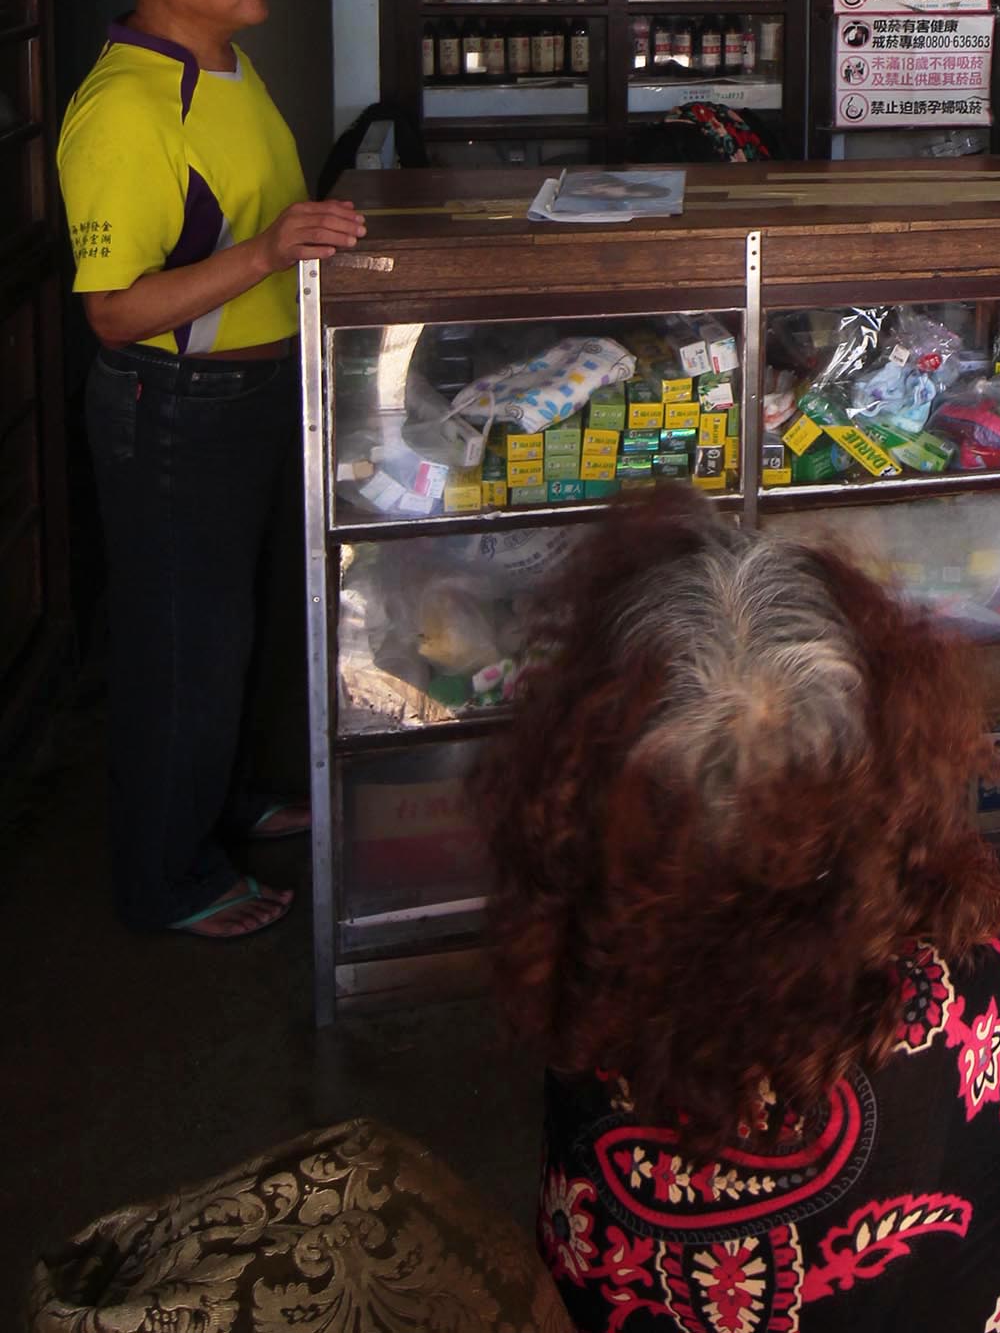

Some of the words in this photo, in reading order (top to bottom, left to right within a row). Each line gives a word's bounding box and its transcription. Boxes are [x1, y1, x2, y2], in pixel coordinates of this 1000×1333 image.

[873, 20, 959, 33] 吸菸有害健康
[872, 57, 984, 70] 未滿18歲不得吸菸
[871, 73, 982, 86] 及禁止供應其菸品
[841, 429, 888, 467] DARLIE
